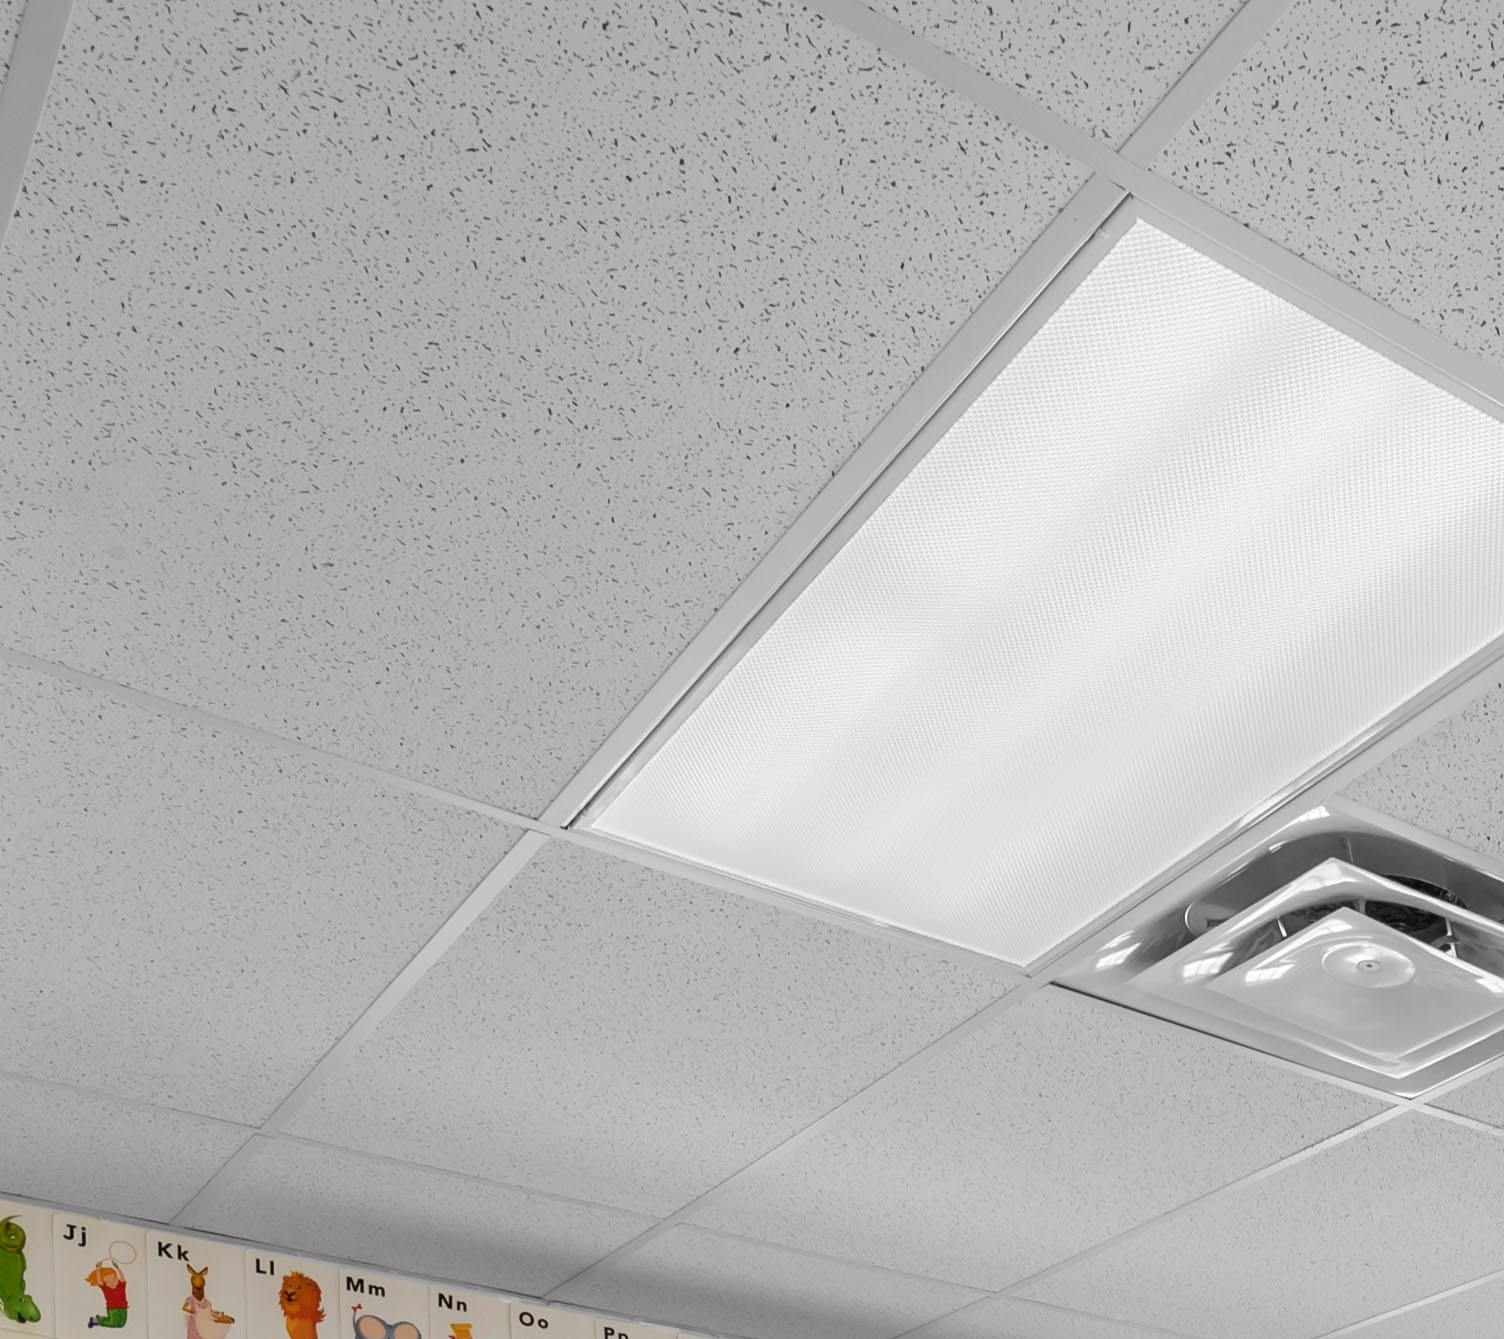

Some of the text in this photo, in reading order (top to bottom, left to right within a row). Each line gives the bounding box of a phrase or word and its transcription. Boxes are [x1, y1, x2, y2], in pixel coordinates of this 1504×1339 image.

[62, 1224, 88, 1248] Jj
[157, 1242, 190, 1263] Kk
[255, 1259, 276, 1276] Ll
[346, 1277, 386, 1298] Mm
[438, 1294, 468, 1313] Nn
[519, 1312, 549, 1330] Oo
